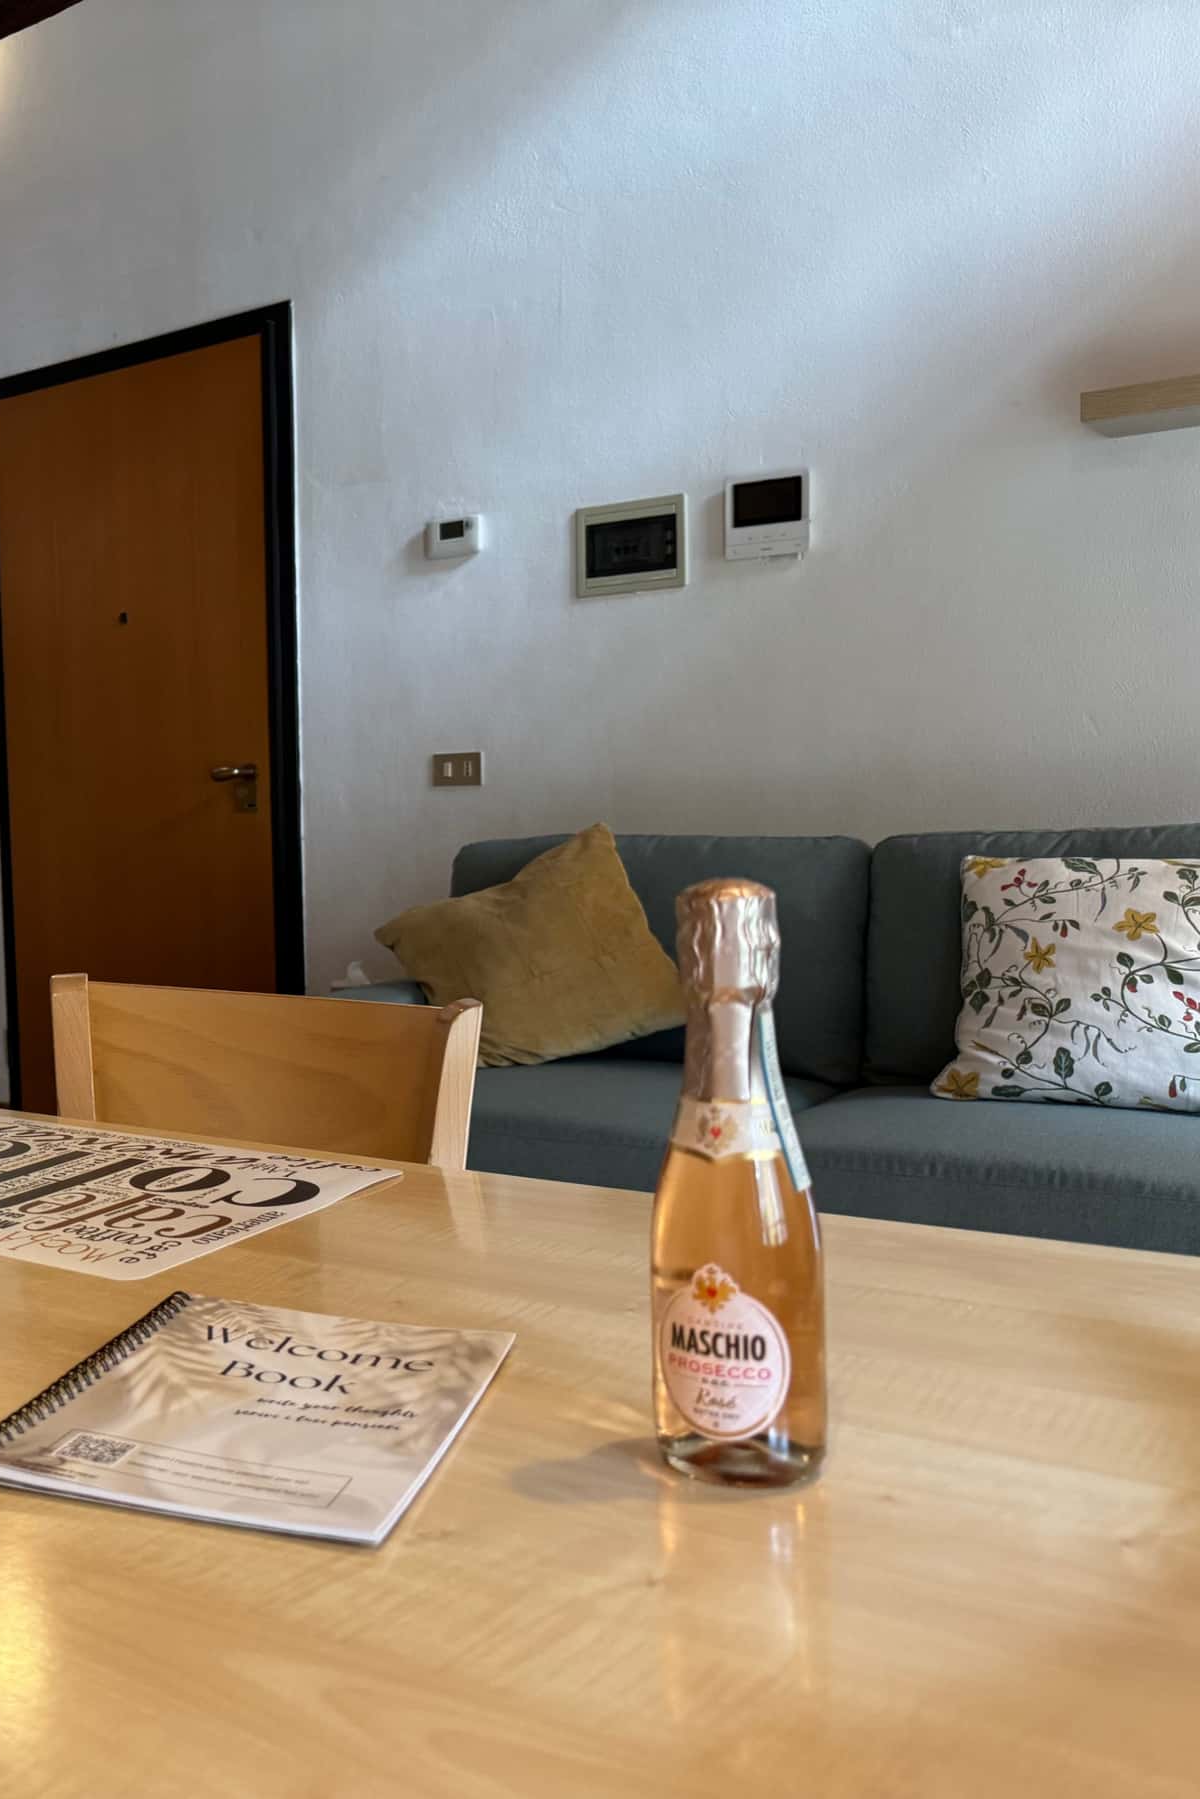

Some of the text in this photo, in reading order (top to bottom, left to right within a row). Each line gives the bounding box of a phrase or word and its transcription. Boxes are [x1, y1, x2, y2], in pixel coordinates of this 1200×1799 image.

[254, 1155, 381, 1171] coffee
[18, 1192, 230, 1238] cafe
[192, 1211, 284, 1244] americano
[56, 1224, 152, 1244] coffee
[119, 1240, 181, 1263] cafe
[205, 1324, 436, 1374] Welcome
[671, 1321, 767, 1363] MASCHIO
[218, 1359, 356, 1397] Book
[668, 1352, 773, 1381] PROSECCO
